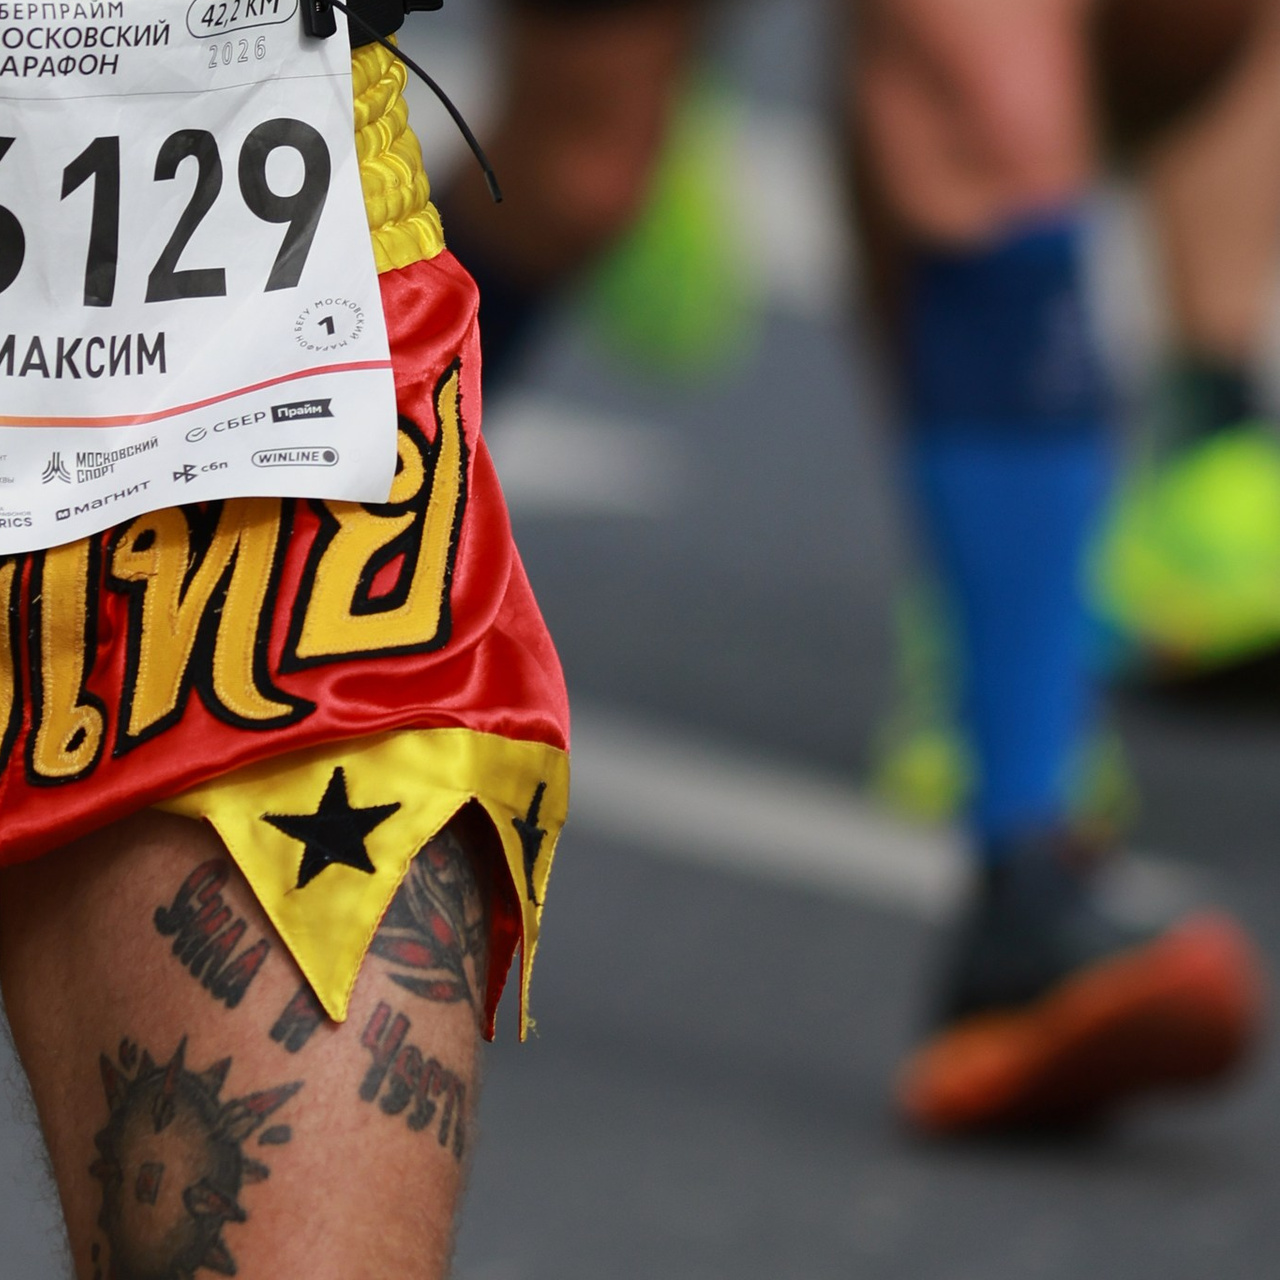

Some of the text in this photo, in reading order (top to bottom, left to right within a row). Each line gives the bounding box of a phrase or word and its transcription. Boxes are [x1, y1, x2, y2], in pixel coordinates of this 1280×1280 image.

[201, 0, 242, 28] 42,2
[208, 36, 267, 69] 2026
[314, 298, 365, 340] МОСКОВСКИЙ
[317, 315, 335, 336] 1
[213, 403, 323, 433] СБЕР Прайм
[76, 436, 159, 468] МОСКОВСКИЙ
[258, 450, 320, 464] WINLINE
[77, 463, 116, 484] СПОРТ
[201, 461, 228, 473] сбп
